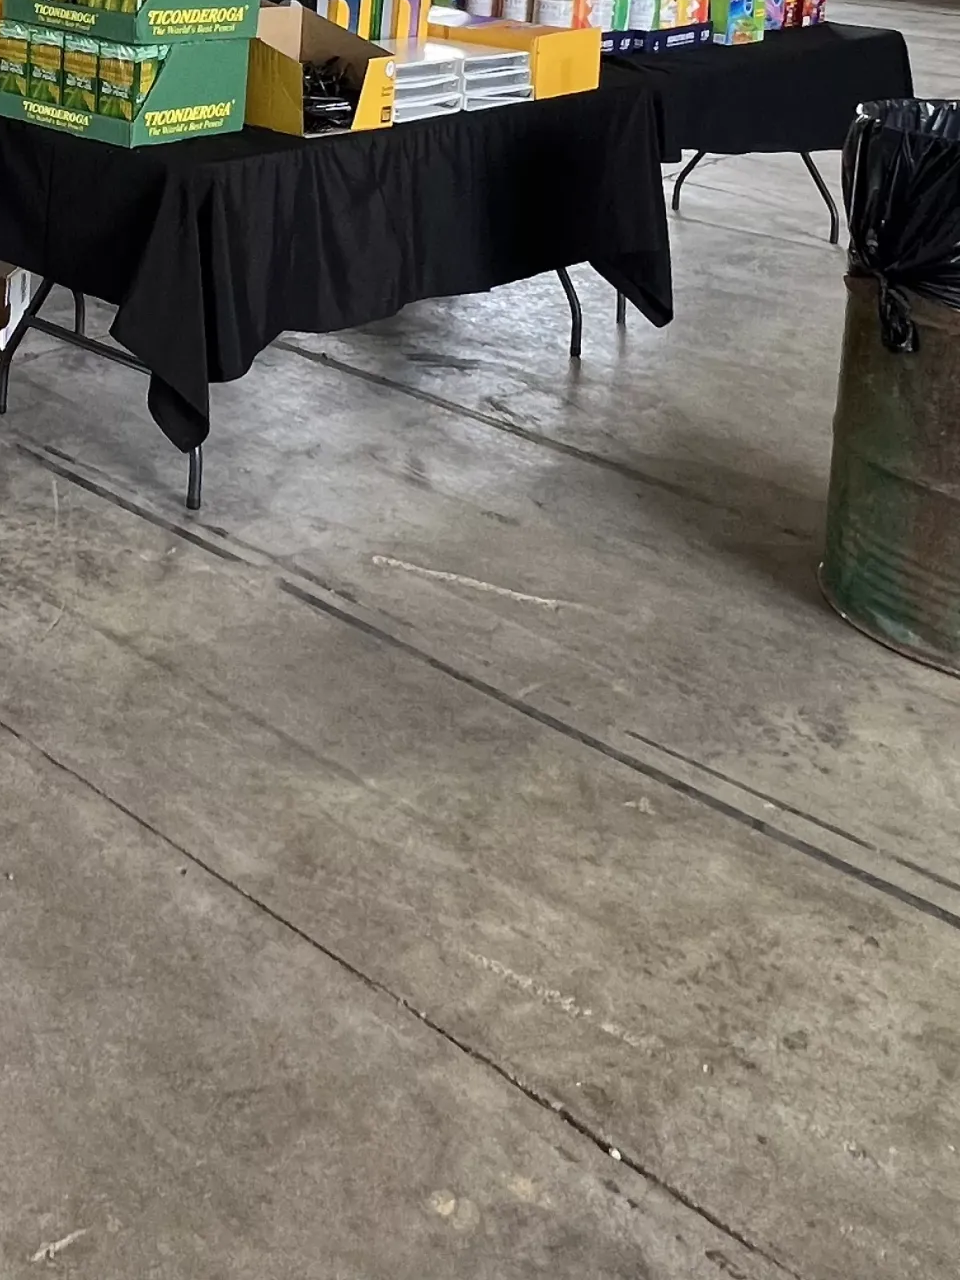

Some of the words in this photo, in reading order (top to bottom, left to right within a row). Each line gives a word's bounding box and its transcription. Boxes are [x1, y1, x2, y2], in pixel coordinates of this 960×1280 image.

[34, 2, 96, 25] TICONDEROGA
[148, 6, 244, 25] TICONDEROGA
[152, 26, 166, 36] The
[167, 24, 196, 35] World's
[197, 24, 213, 33] Best
[213, 23, 235, 32] Pencil
[23, 100, 90, 126] TICONDEROGA
[145, 101, 231, 127] TICONDEROGA
[148, 127, 161, 137] The
